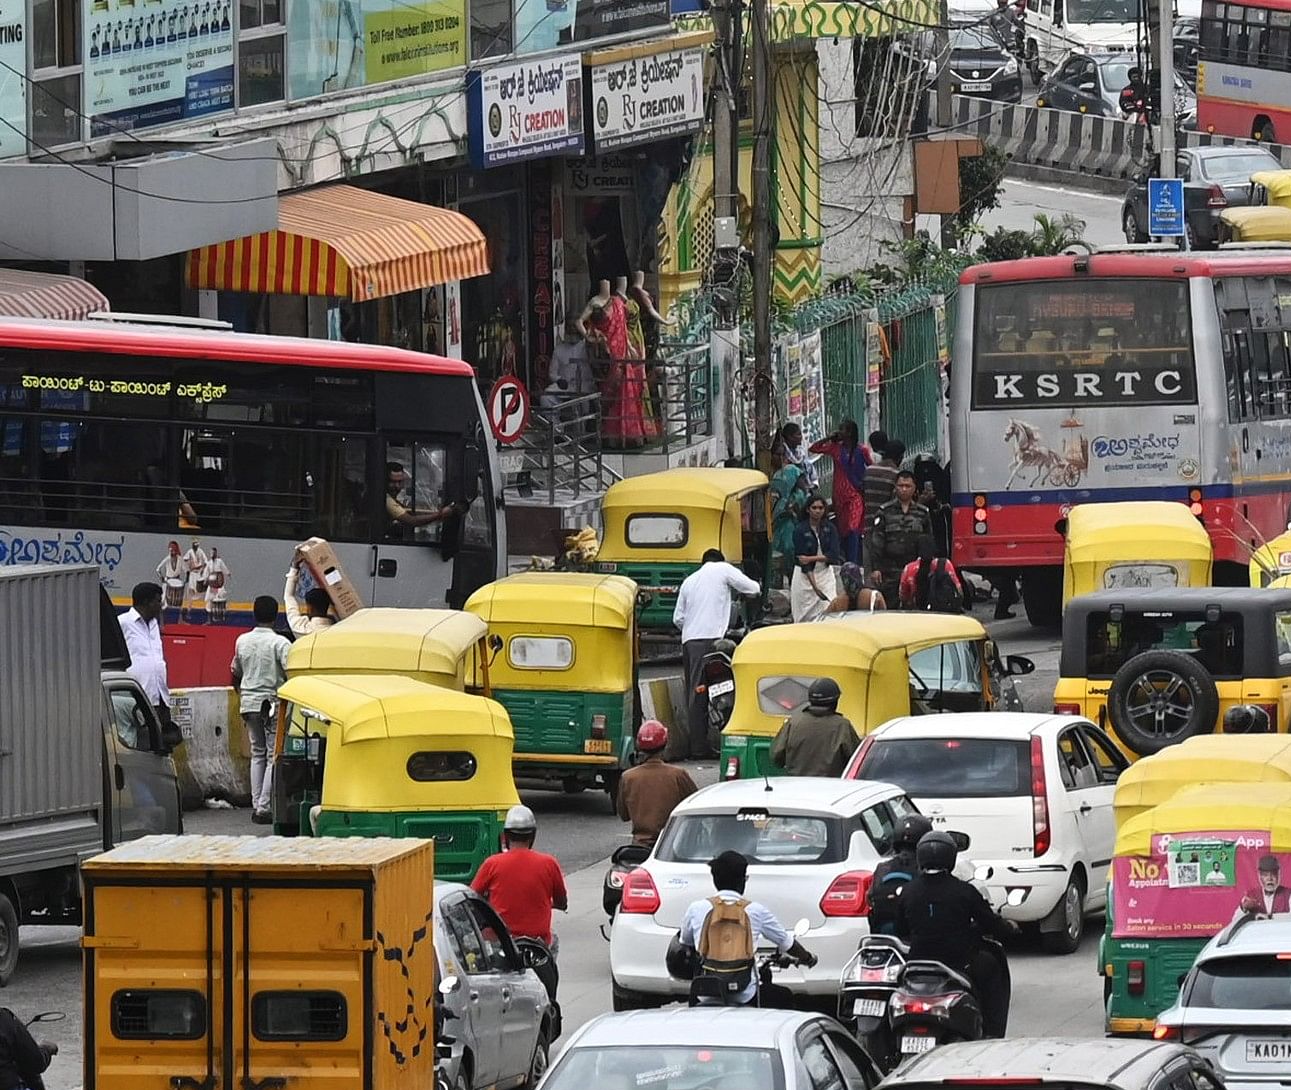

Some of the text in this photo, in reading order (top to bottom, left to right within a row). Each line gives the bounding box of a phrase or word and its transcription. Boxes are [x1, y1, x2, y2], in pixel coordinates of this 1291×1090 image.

[639, 94, 685, 120] CREATION
[524, 108, 565, 133] CREATION
[994, 370, 1182, 399] KSRTC
[1235, 837, 1264, 850] App
[1128, 859, 1159, 880] No
